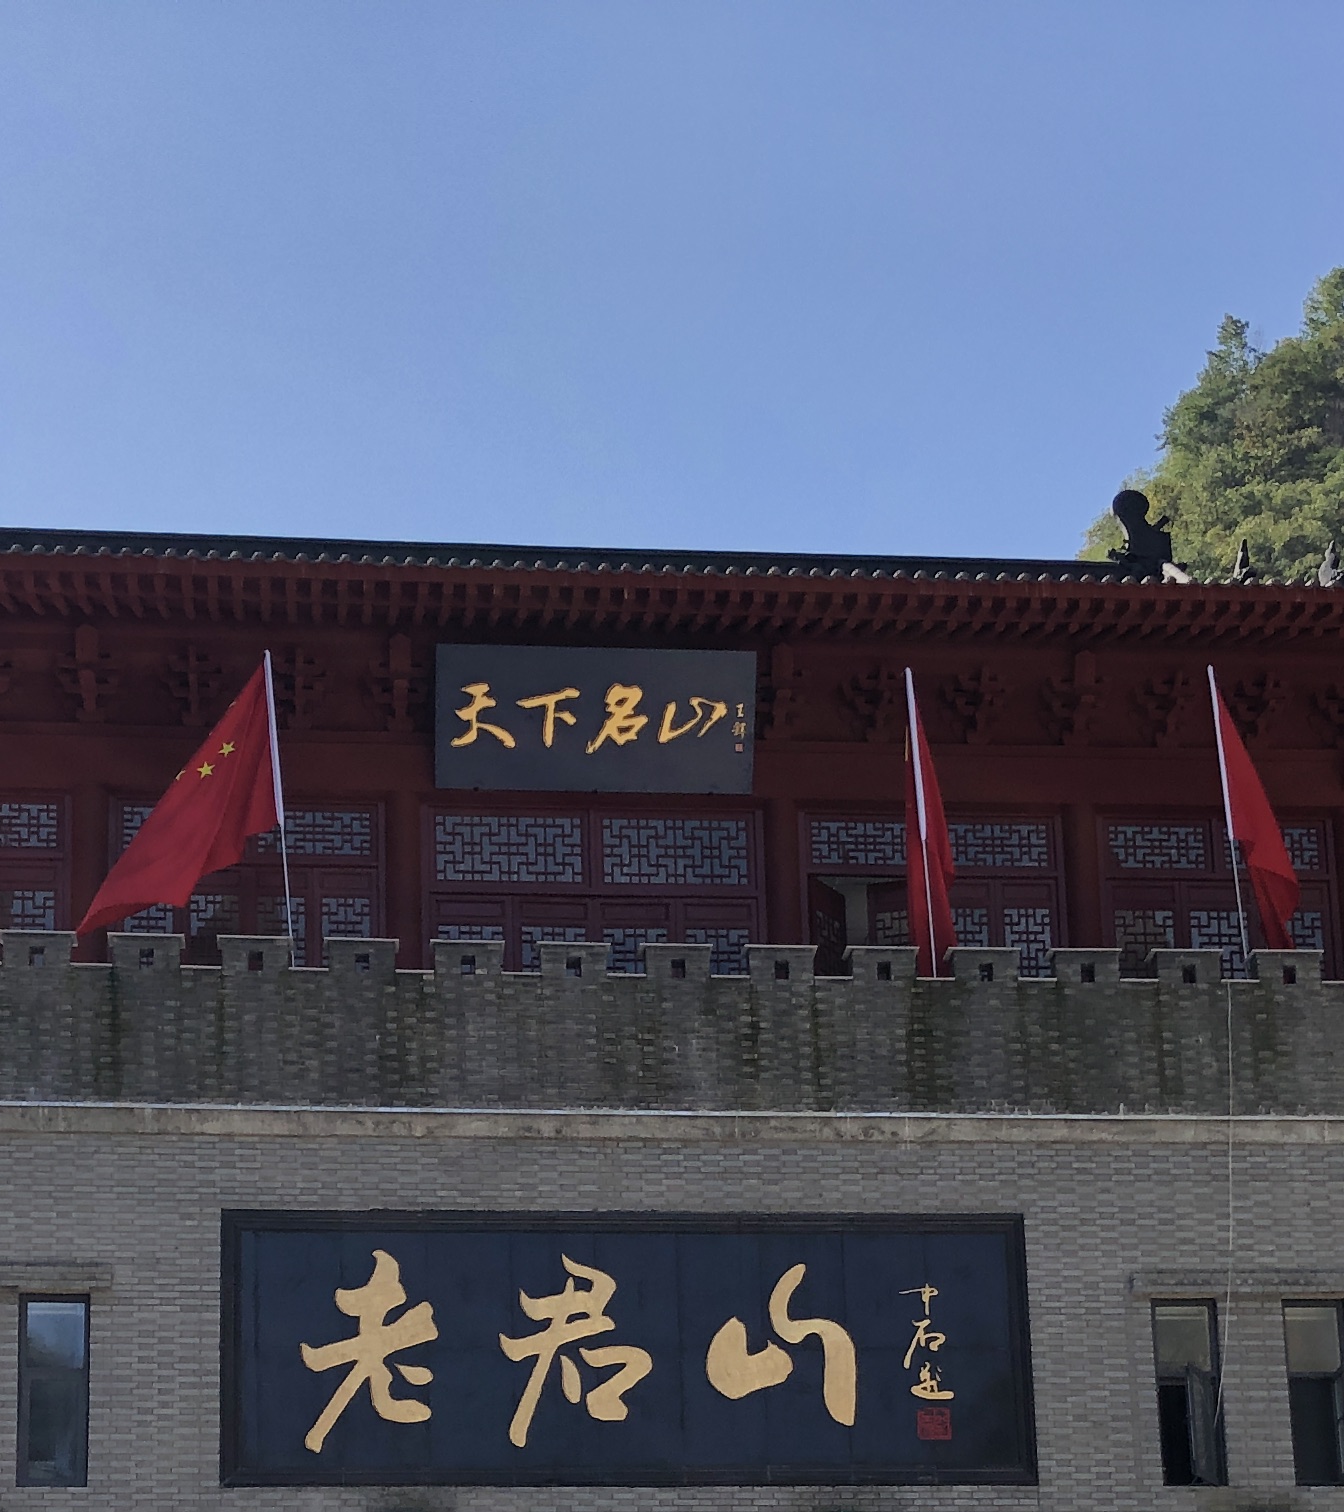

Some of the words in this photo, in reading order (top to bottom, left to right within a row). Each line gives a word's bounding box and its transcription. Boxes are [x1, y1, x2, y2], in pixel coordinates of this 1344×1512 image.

[451, 682, 728, 754] 天下名山
[299, 1248, 856, 1454] 老君山
